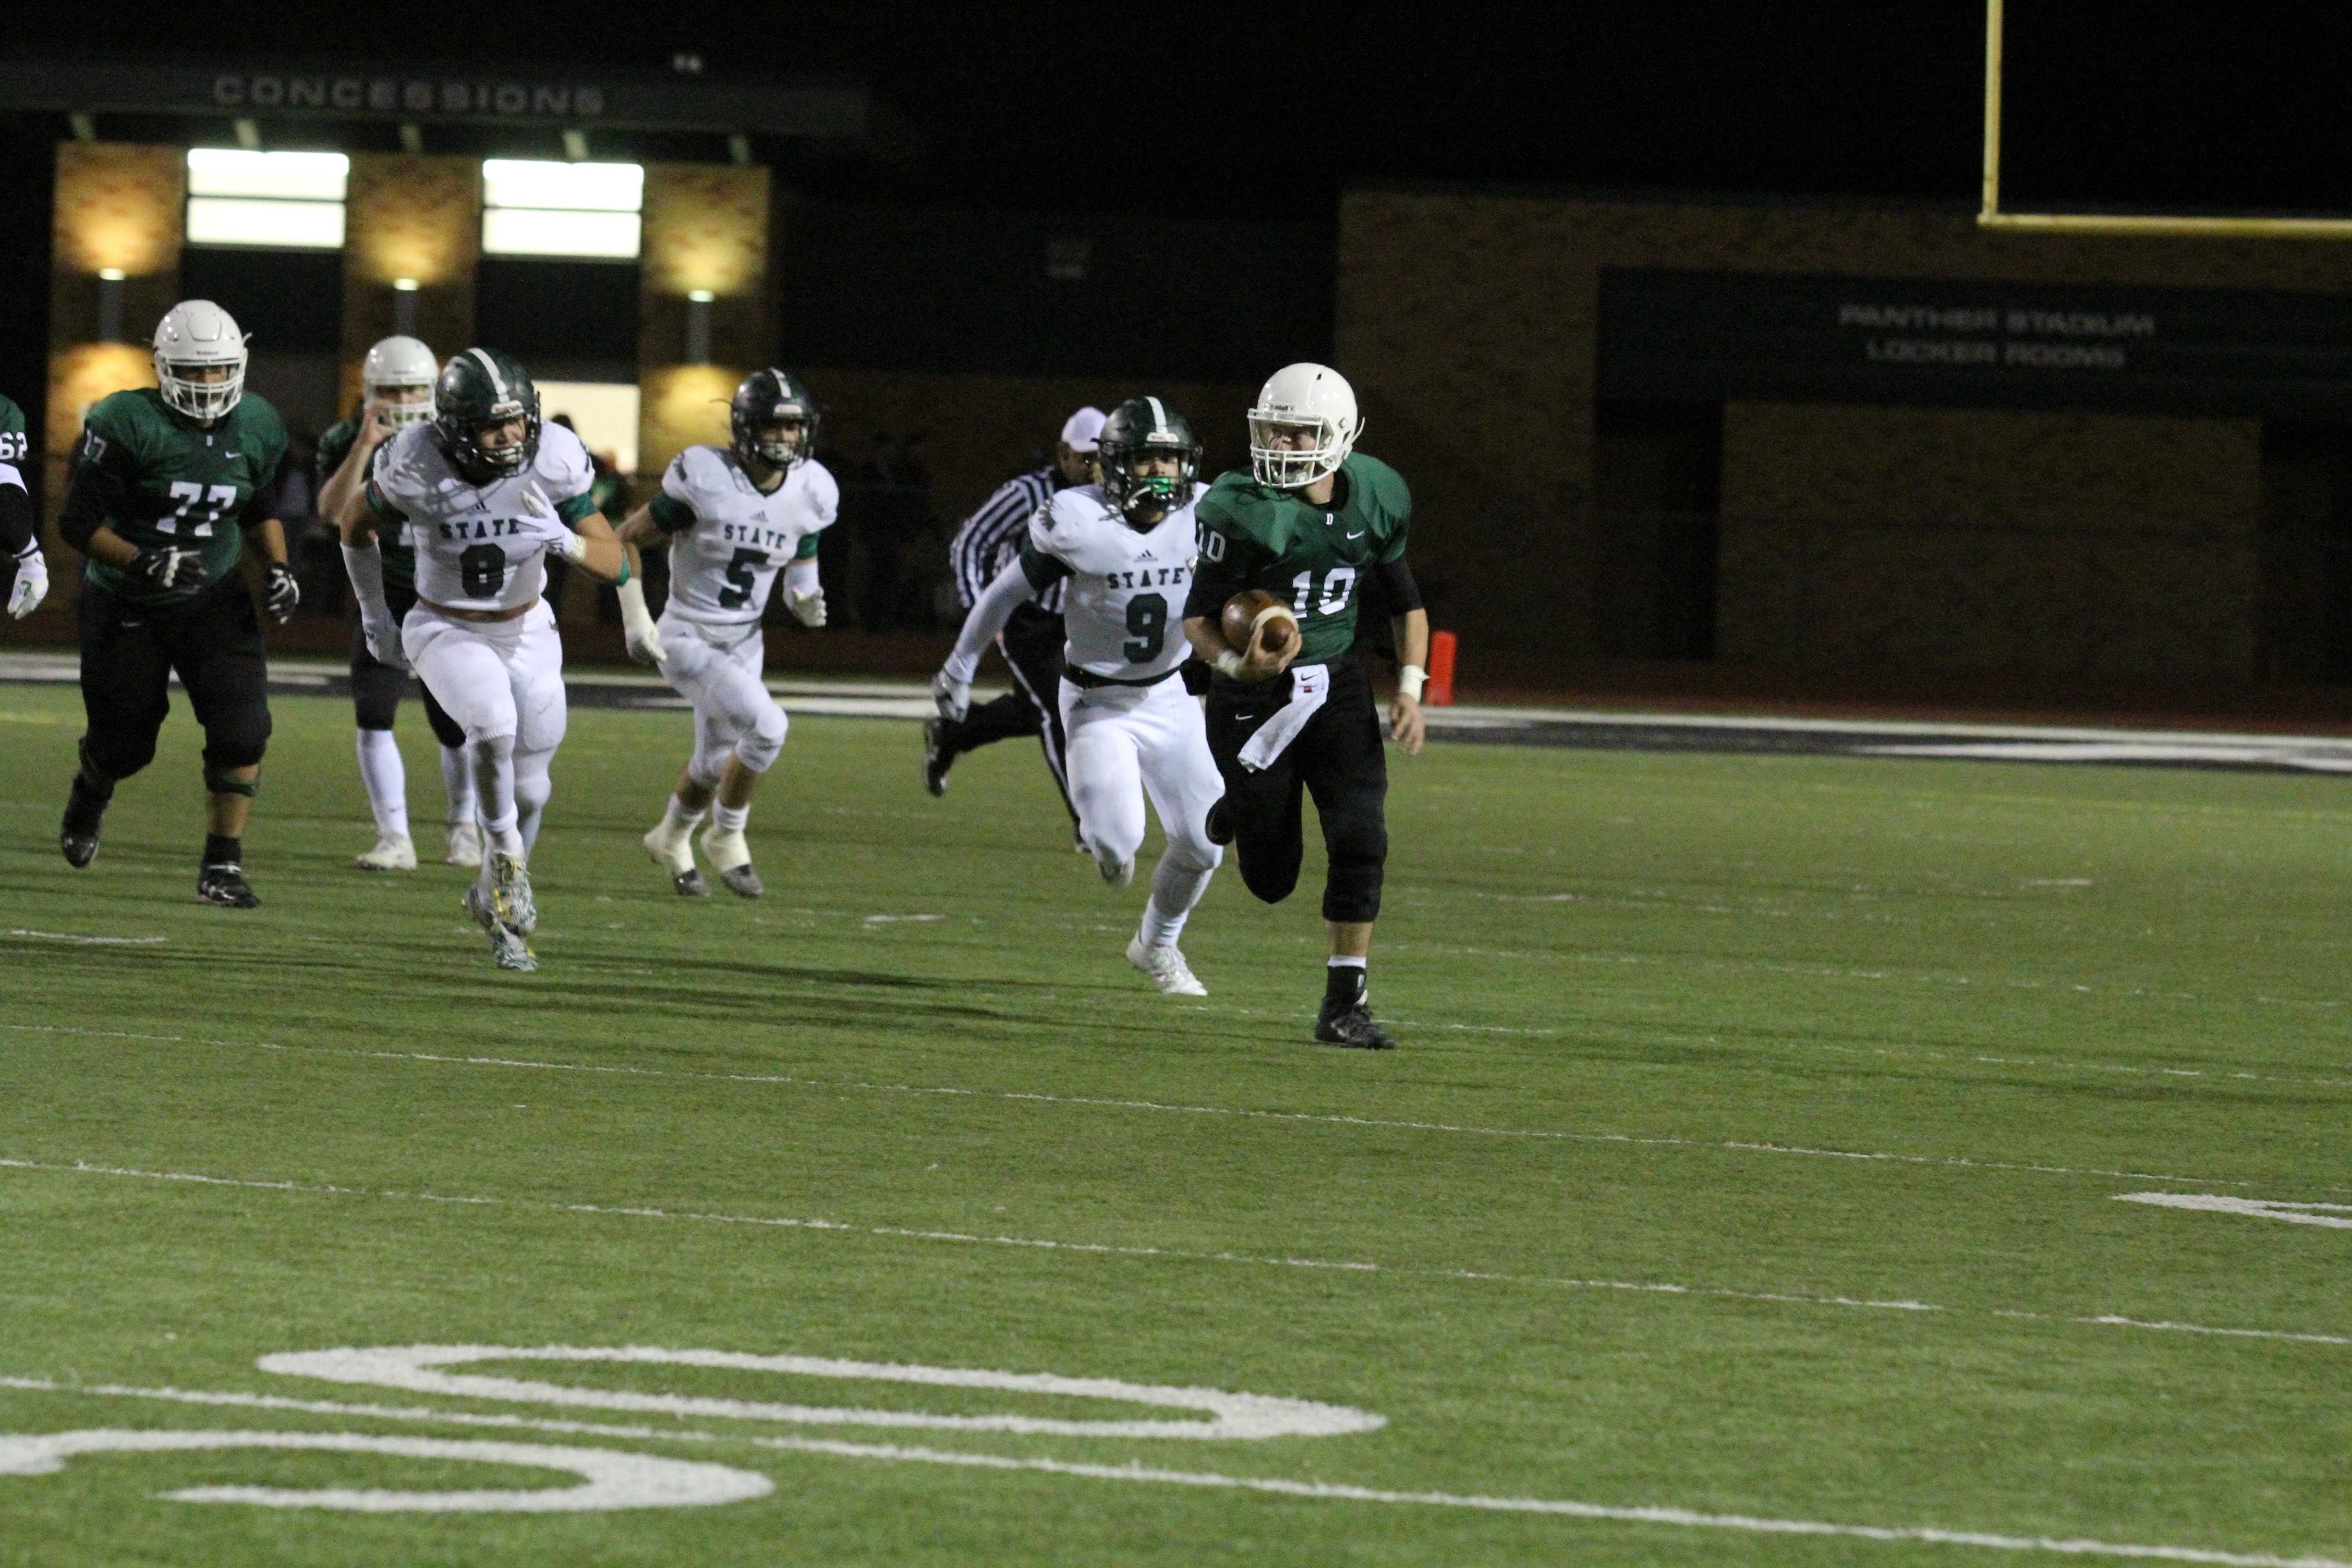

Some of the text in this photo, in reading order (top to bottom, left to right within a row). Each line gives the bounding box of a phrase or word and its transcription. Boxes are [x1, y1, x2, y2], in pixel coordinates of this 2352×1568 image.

[213, 72, 604, 117] CONCESSIONS
[1838, 303, 2155, 336] PANTHER STADIUM
[1866, 338, 2126, 368] LOCKER ROOMS
[156, 481, 237, 537] 77
[438, 518, 520, 539] STATE
[1325, 513, 1334, 525] D
[724, 524, 787, 549] STATE
[1198, 522, 1226, 563] 10
[460, 543, 506, 598] 8
[718, 547, 771, 608] 5
[1106, 567, 1185, 589] STATE
[1292, 567, 1356, 620] 10
[1123, 593, 1168, 664] 9
